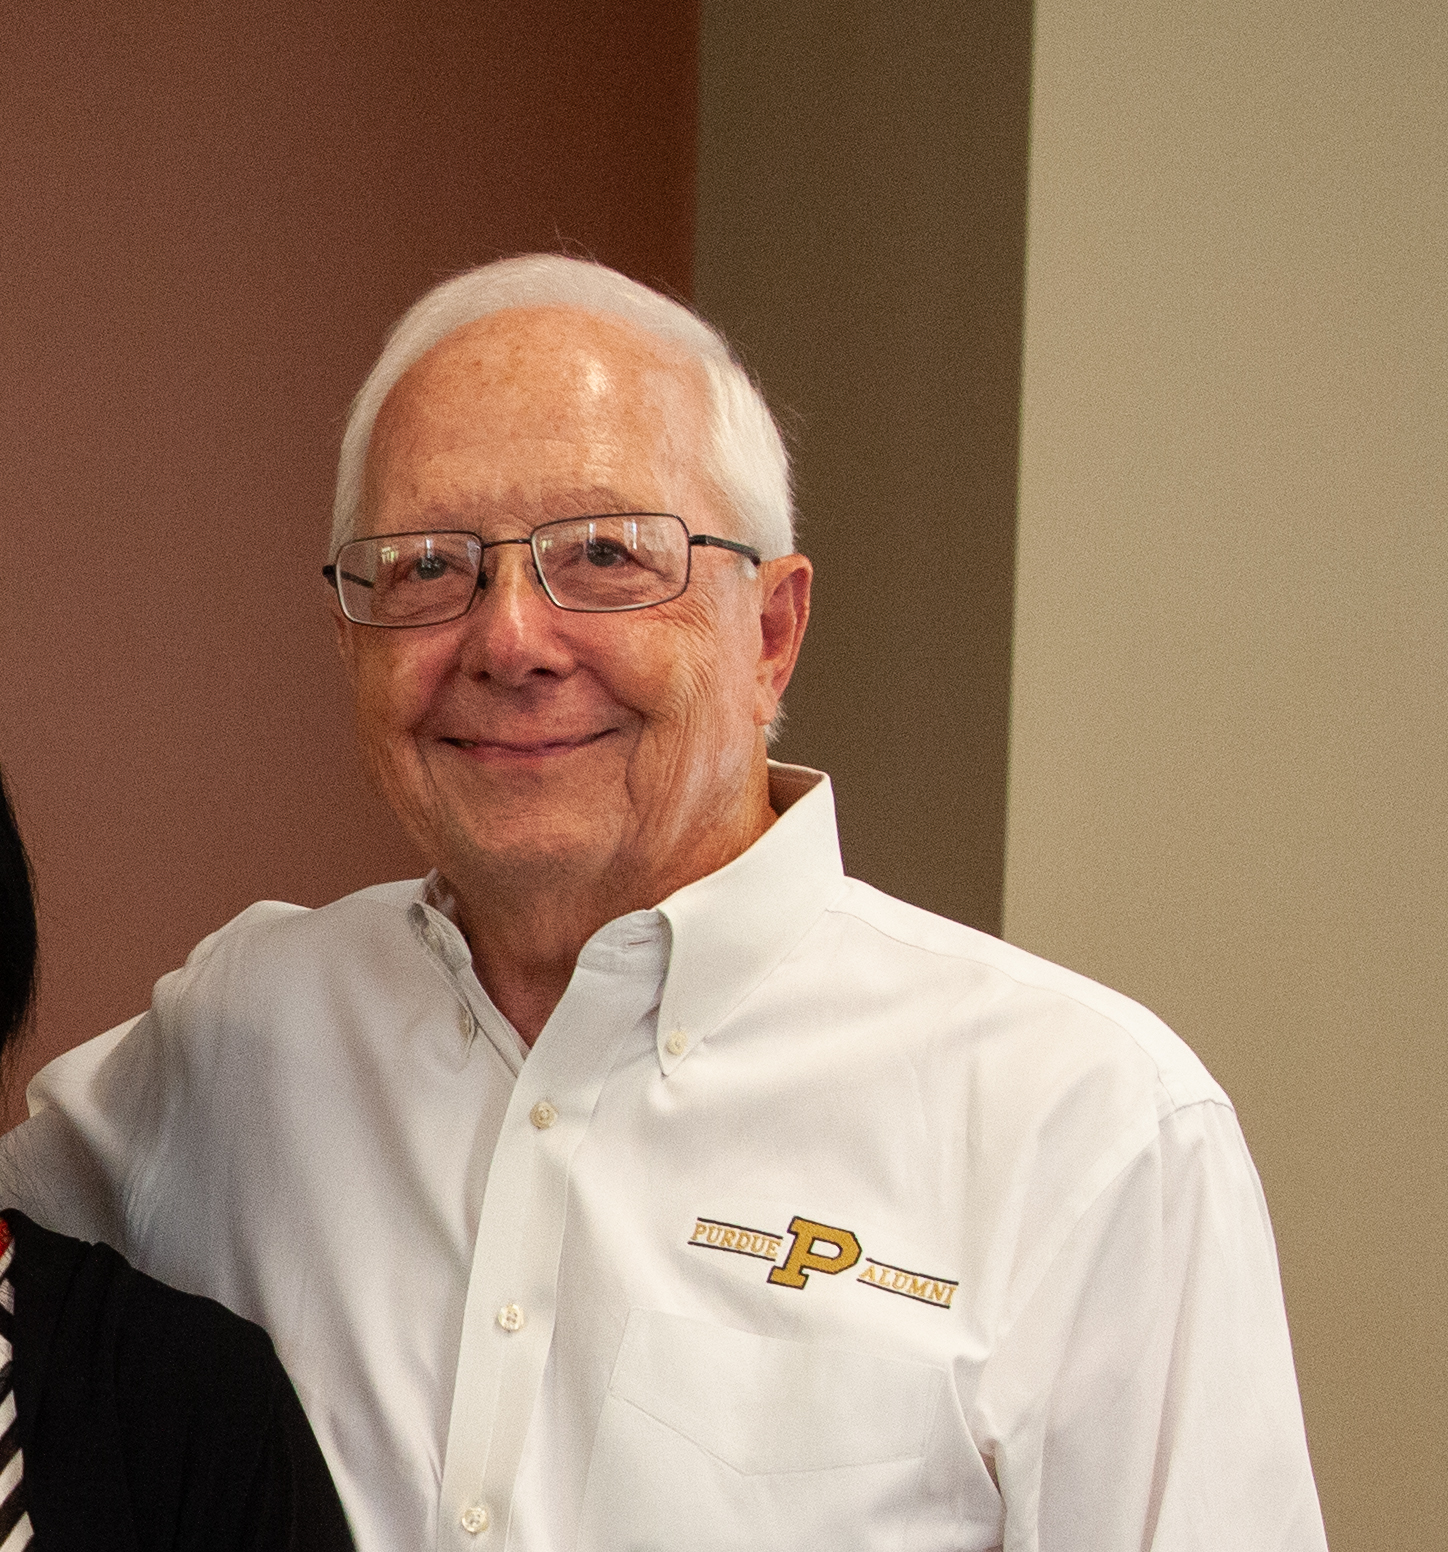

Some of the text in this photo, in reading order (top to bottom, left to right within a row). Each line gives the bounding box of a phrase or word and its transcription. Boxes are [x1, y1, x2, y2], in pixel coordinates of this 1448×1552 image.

[689, 1215, 958, 1306] PURDUE P ALUMNI
